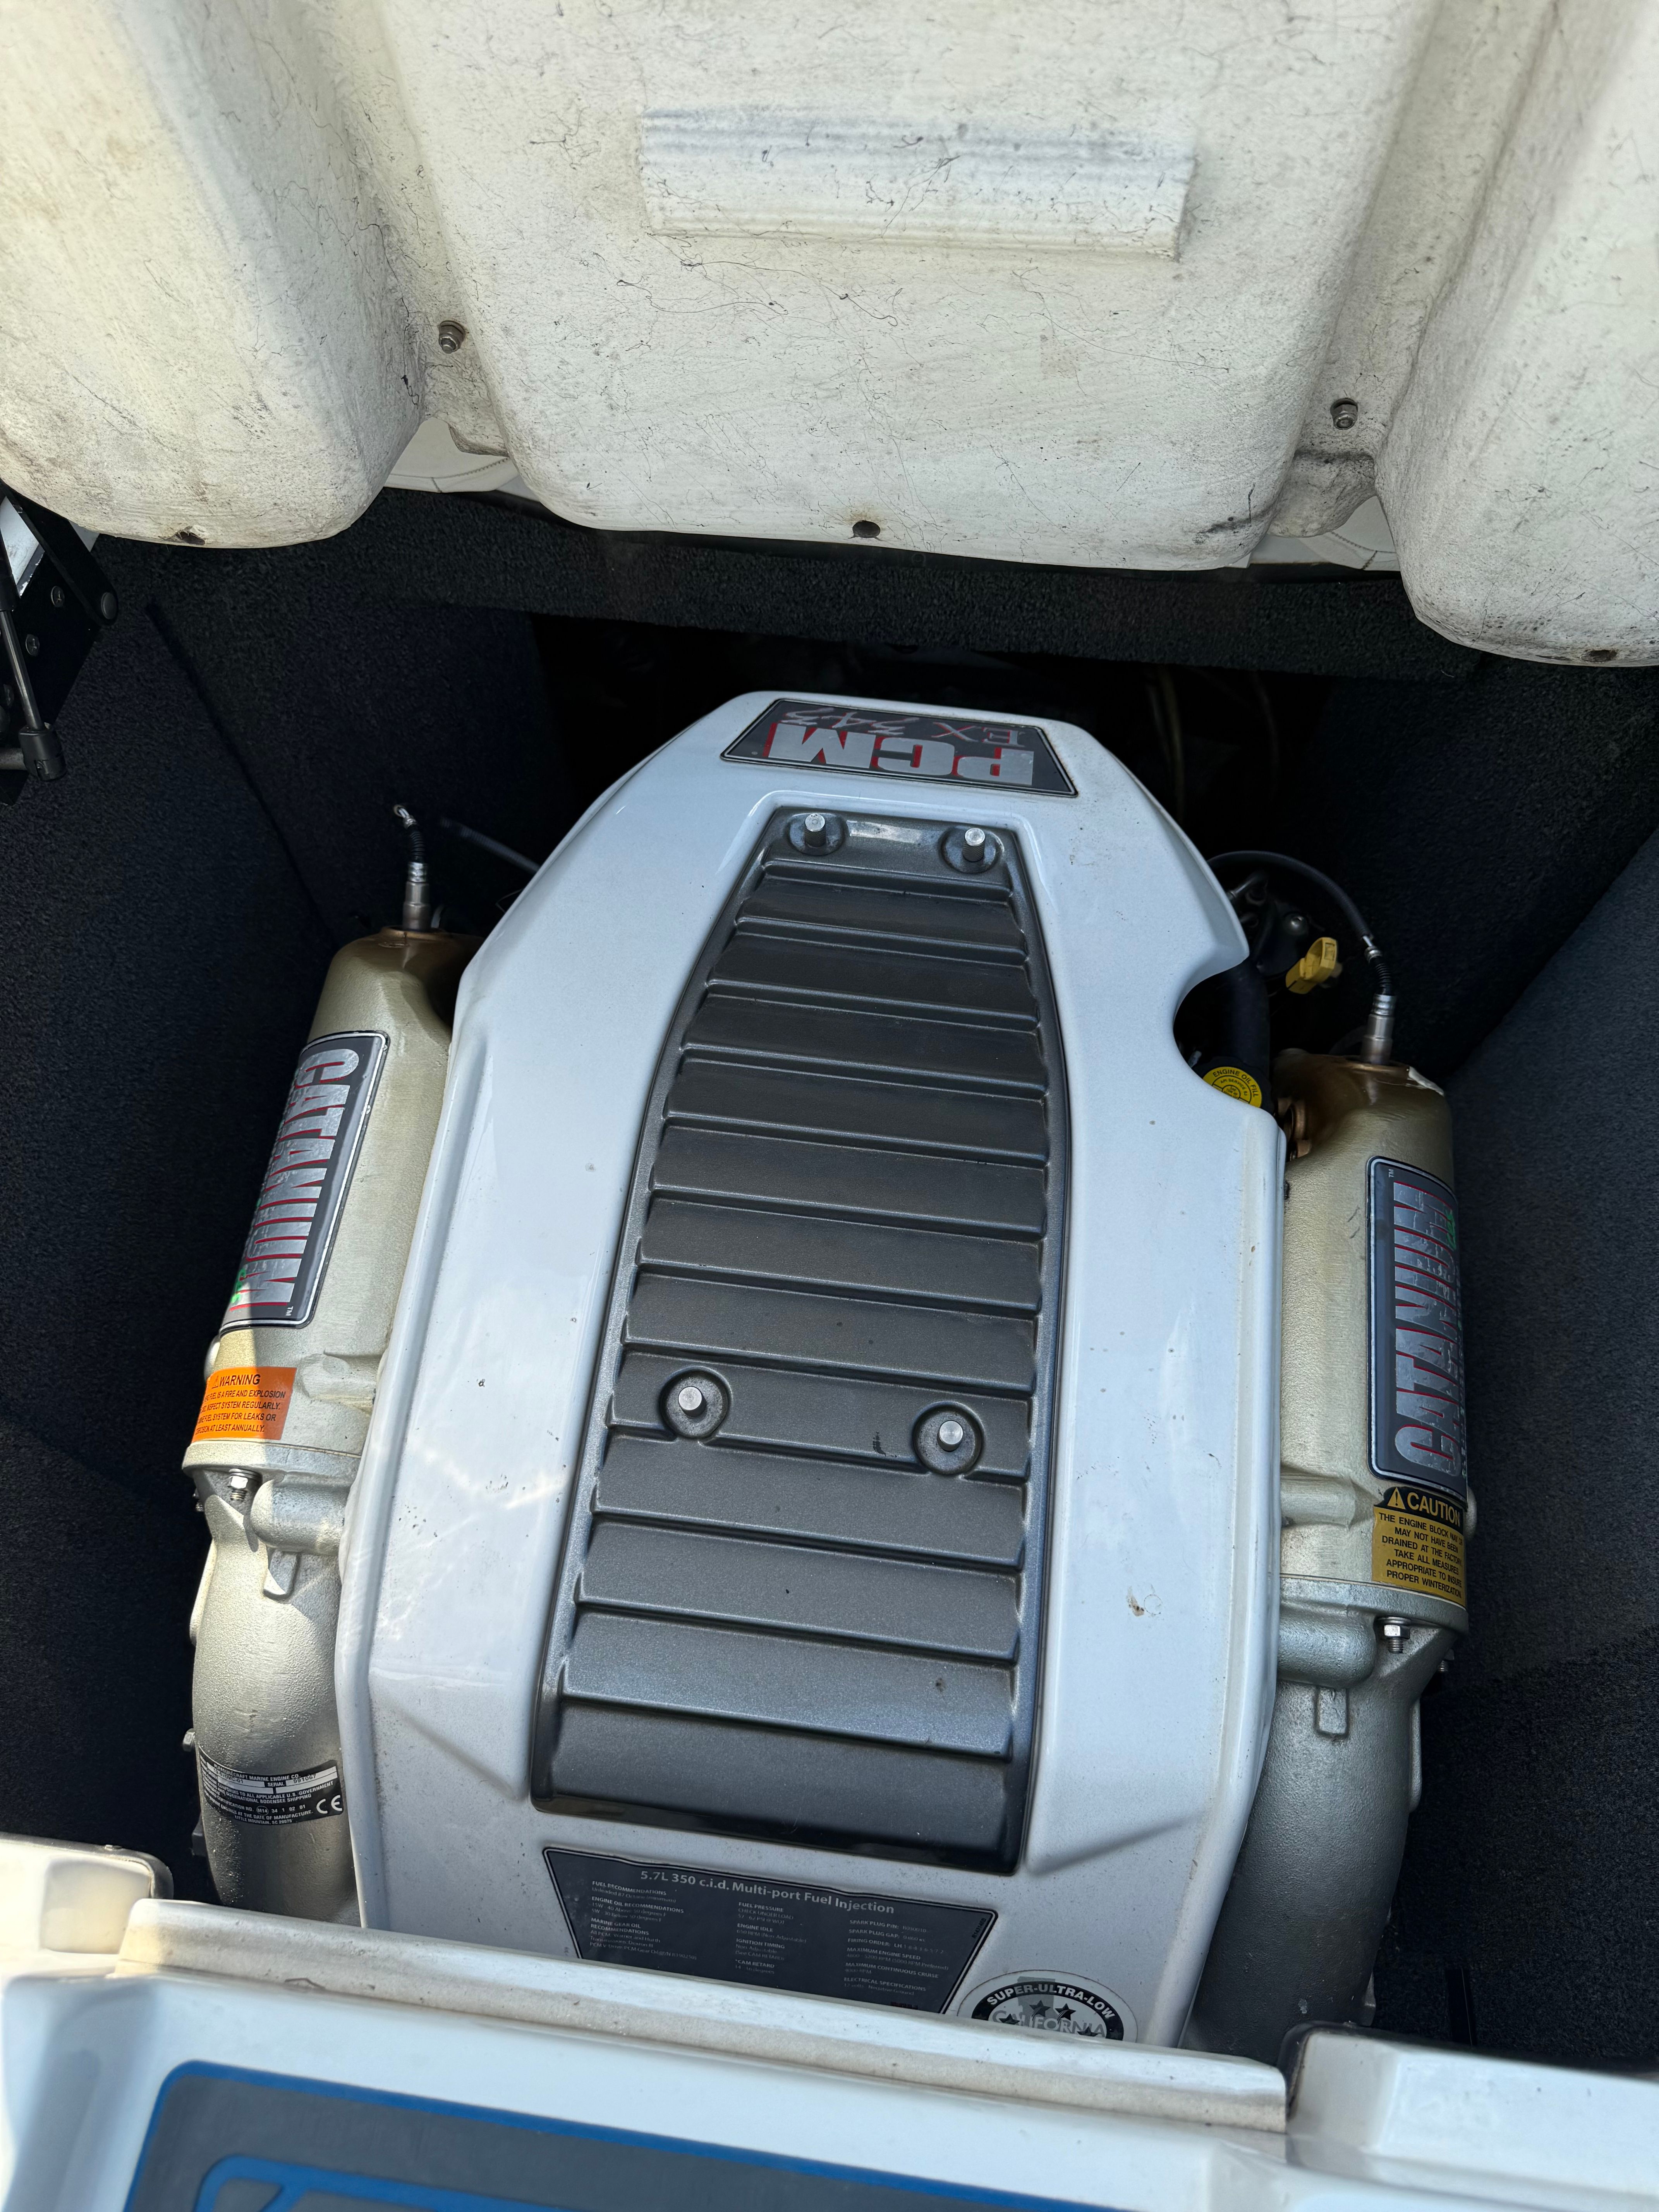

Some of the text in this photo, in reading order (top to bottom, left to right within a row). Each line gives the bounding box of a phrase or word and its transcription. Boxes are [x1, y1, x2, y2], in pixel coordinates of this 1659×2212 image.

[778, 708, 1025, 747] EX 343
[763, 722, 1034, 785] PCM
[1213, 1069, 1240, 1077] ENGINE
[1241, 1074, 1251, 1084] OIL
[1250, 1084, 1259, 1097] FILL
[230, 1049, 359, 1311] CATANIUM
[1394, 1181, 1461, 1476] CATANIUM
[219, 1374, 261, 1387] WARNING
[249, 1390, 285, 1398] EXPLOSION
[242, 1401, 280, 1410] REGULARLY.
[1407, 1492, 1460, 1527] CAUTION
[1379, 1512, 1395, 1522] THE
[1399, 1517, 1427, 1530] ENGINE
[1429, 1525, 1448, 1538] BLOCK
[1382, 1535, 1418, 1549] DRAINED
[1420, 1544, 1429, 1553] AT
[1431, 1547, 1443, 1557] THE
[1395, 1527, 1458, 1553] MAY NOT HAVE BEEN
[1386, 1559, 1437, 1577] APPROPRIATE
[1438, 1571, 1446, 1580] TO
[1394, 1549, 1459, 1575] TAKE ALL MEASURES
[1386, 1570, 1419, 1584] PROPER
[214, 1764, 248, 1779] PLEASURECRAFT
[218, 1783, 239, 1795] CONFORMS
[299, 1781, 333, 1796] GOVERNMENT
[217, 1795, 245, 1810] CERTIFICATION
[226, 1791, 259, 1803] INTERNATIONAL
[287, 1793, 312, 1803] SHIPPING
[316, 1795, 343, 1814] CE
[274, 1810, 313, 1819] MANUFACTURE.
[592, 1887, 617, 1896] Unleaded
[608, 1883, 666, 1895] RECOMMENDATIONS
[641, 1871, 894, 1914] 5.7L 350 c.i.d. Multi-port Fuel Injection
[625, 1902, 684, 1913] RECOMMENDATIONS
[754, 1904, 784, 1912] PRESSURE
[591, 1917, 613, 1925] MARINE
[591, 1923, 649, 1935] RECOMMENDATIONS
[877, 1965, 916, 1975] CONTINUOUS
[879, 1981, 926, 1991] SPECIFICATIONS
[987, 1984, 1116, 2019] SUPER-ULTRA-LOW
